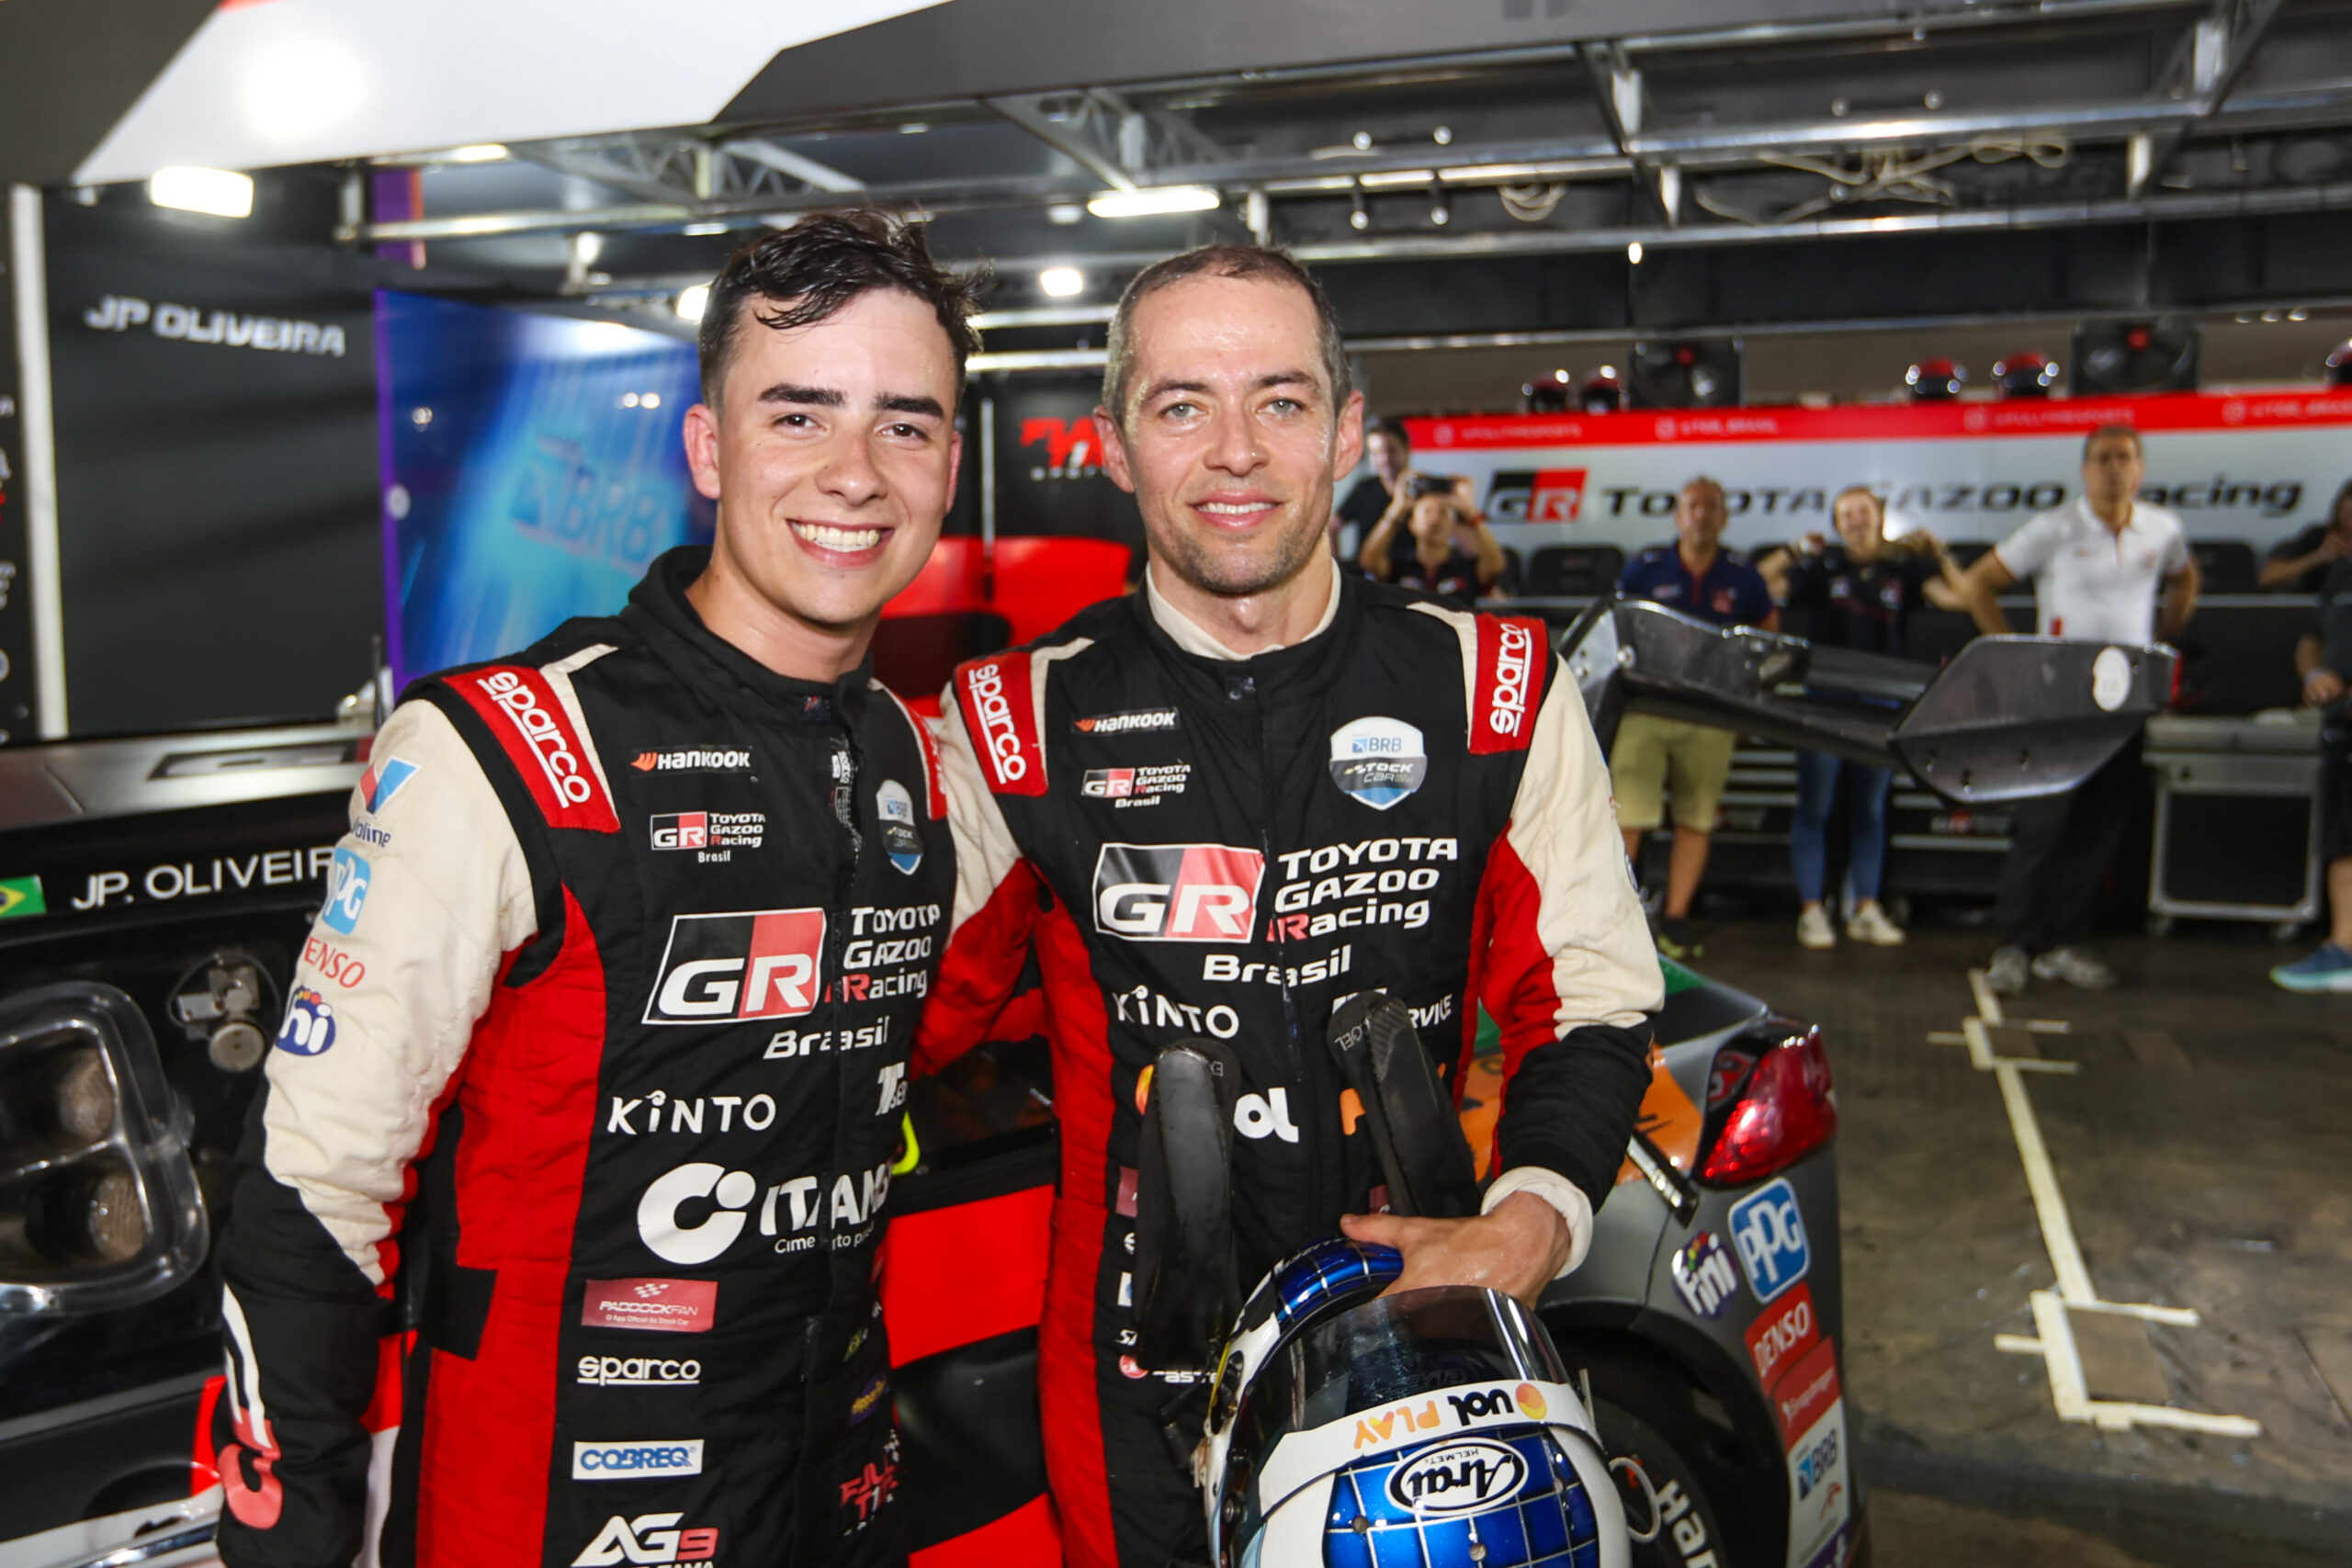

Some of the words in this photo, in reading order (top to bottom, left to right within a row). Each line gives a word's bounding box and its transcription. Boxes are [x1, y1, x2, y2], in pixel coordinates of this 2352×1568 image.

[85, 294, 151, 332] JP
[153, 302, 346, 357] OLIVEIRA
[1601, 486, 1828, 517] TOOTA
[2132, 471, 2304, 517] acing
[1490, 622, 1532, 738] sparco
[479, 671, 592, 809] sparco
[969, 663, 1027, 784] sparco
[1368, 737, 1403, 752] BRB
[1083, 779, 1130, 795] GR
[1135, 773, 1187, 786] GAZOO
[1135, 783, 1185, 795] Racing
[1137, 763, 1192, 776] TOYOTA
[709, 813, 766, 825] TOYOTA
[1114, 795, 1161, 809] Brasil
[653, 826, 706, 848] GR
[709, 824, 764, 835] GAZOO
[710, 835, 763, 848] Racing
[697, 849, 732, 863] Brasil
[1277, 837, 1459, 880] TOYOTA
[71, 871, 134, 910] JP.
[1098, 882, 1257, 935] GR
[1273, 867, 1441, 914] GAZOO
[851, 903, 941, 937] TOYOTA
[1266, 898, 1430, 943] Racing
[303, 936, 367, 989] ENSO
[842, 935, 933, 970] GAZOO
[1203, 944, 1352, 988] Brasil
[658, 953, 815, 1017] GR
[823, 968, 928, 1003] Racing
[763, 1016, 890, 1059] Brasil
[1736, 1199, 1803, 1285] PPG
[599, 1301, 699, 1316] PADDOCKFAN
[1753, 1301, 1811, 1378] DENSO
[577, 1355, 702, 1386] sparco
[1353, 1399, 1442, 1450] PLAY
[1447, 1388, 1515, 1427] uol
[1407, 1454, 1515, 1499] Arai
[570, 1512, 720, 1567] AG9
